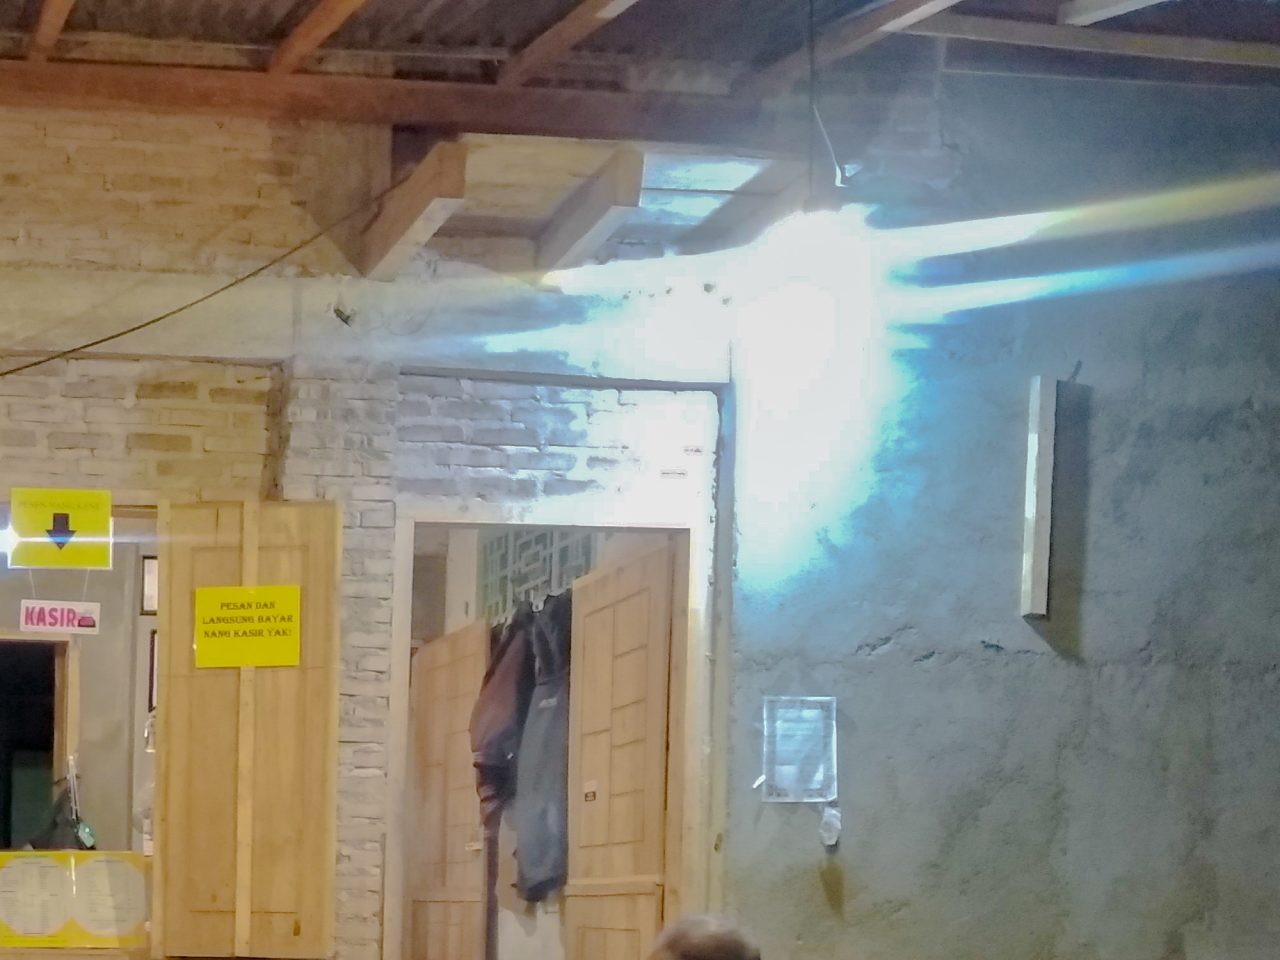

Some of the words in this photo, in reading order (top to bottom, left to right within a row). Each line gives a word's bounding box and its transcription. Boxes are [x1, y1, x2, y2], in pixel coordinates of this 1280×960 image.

[220, 602, 252, 610] PESAN
[255, 601, 276, 610] DAN
[25, 606, 76, 627] KASIR
[202, 616, 255, 625] LANGSUNG
[257, 614, 294, 624] BAYAR
[233, 629, 264, 638] KASIR
